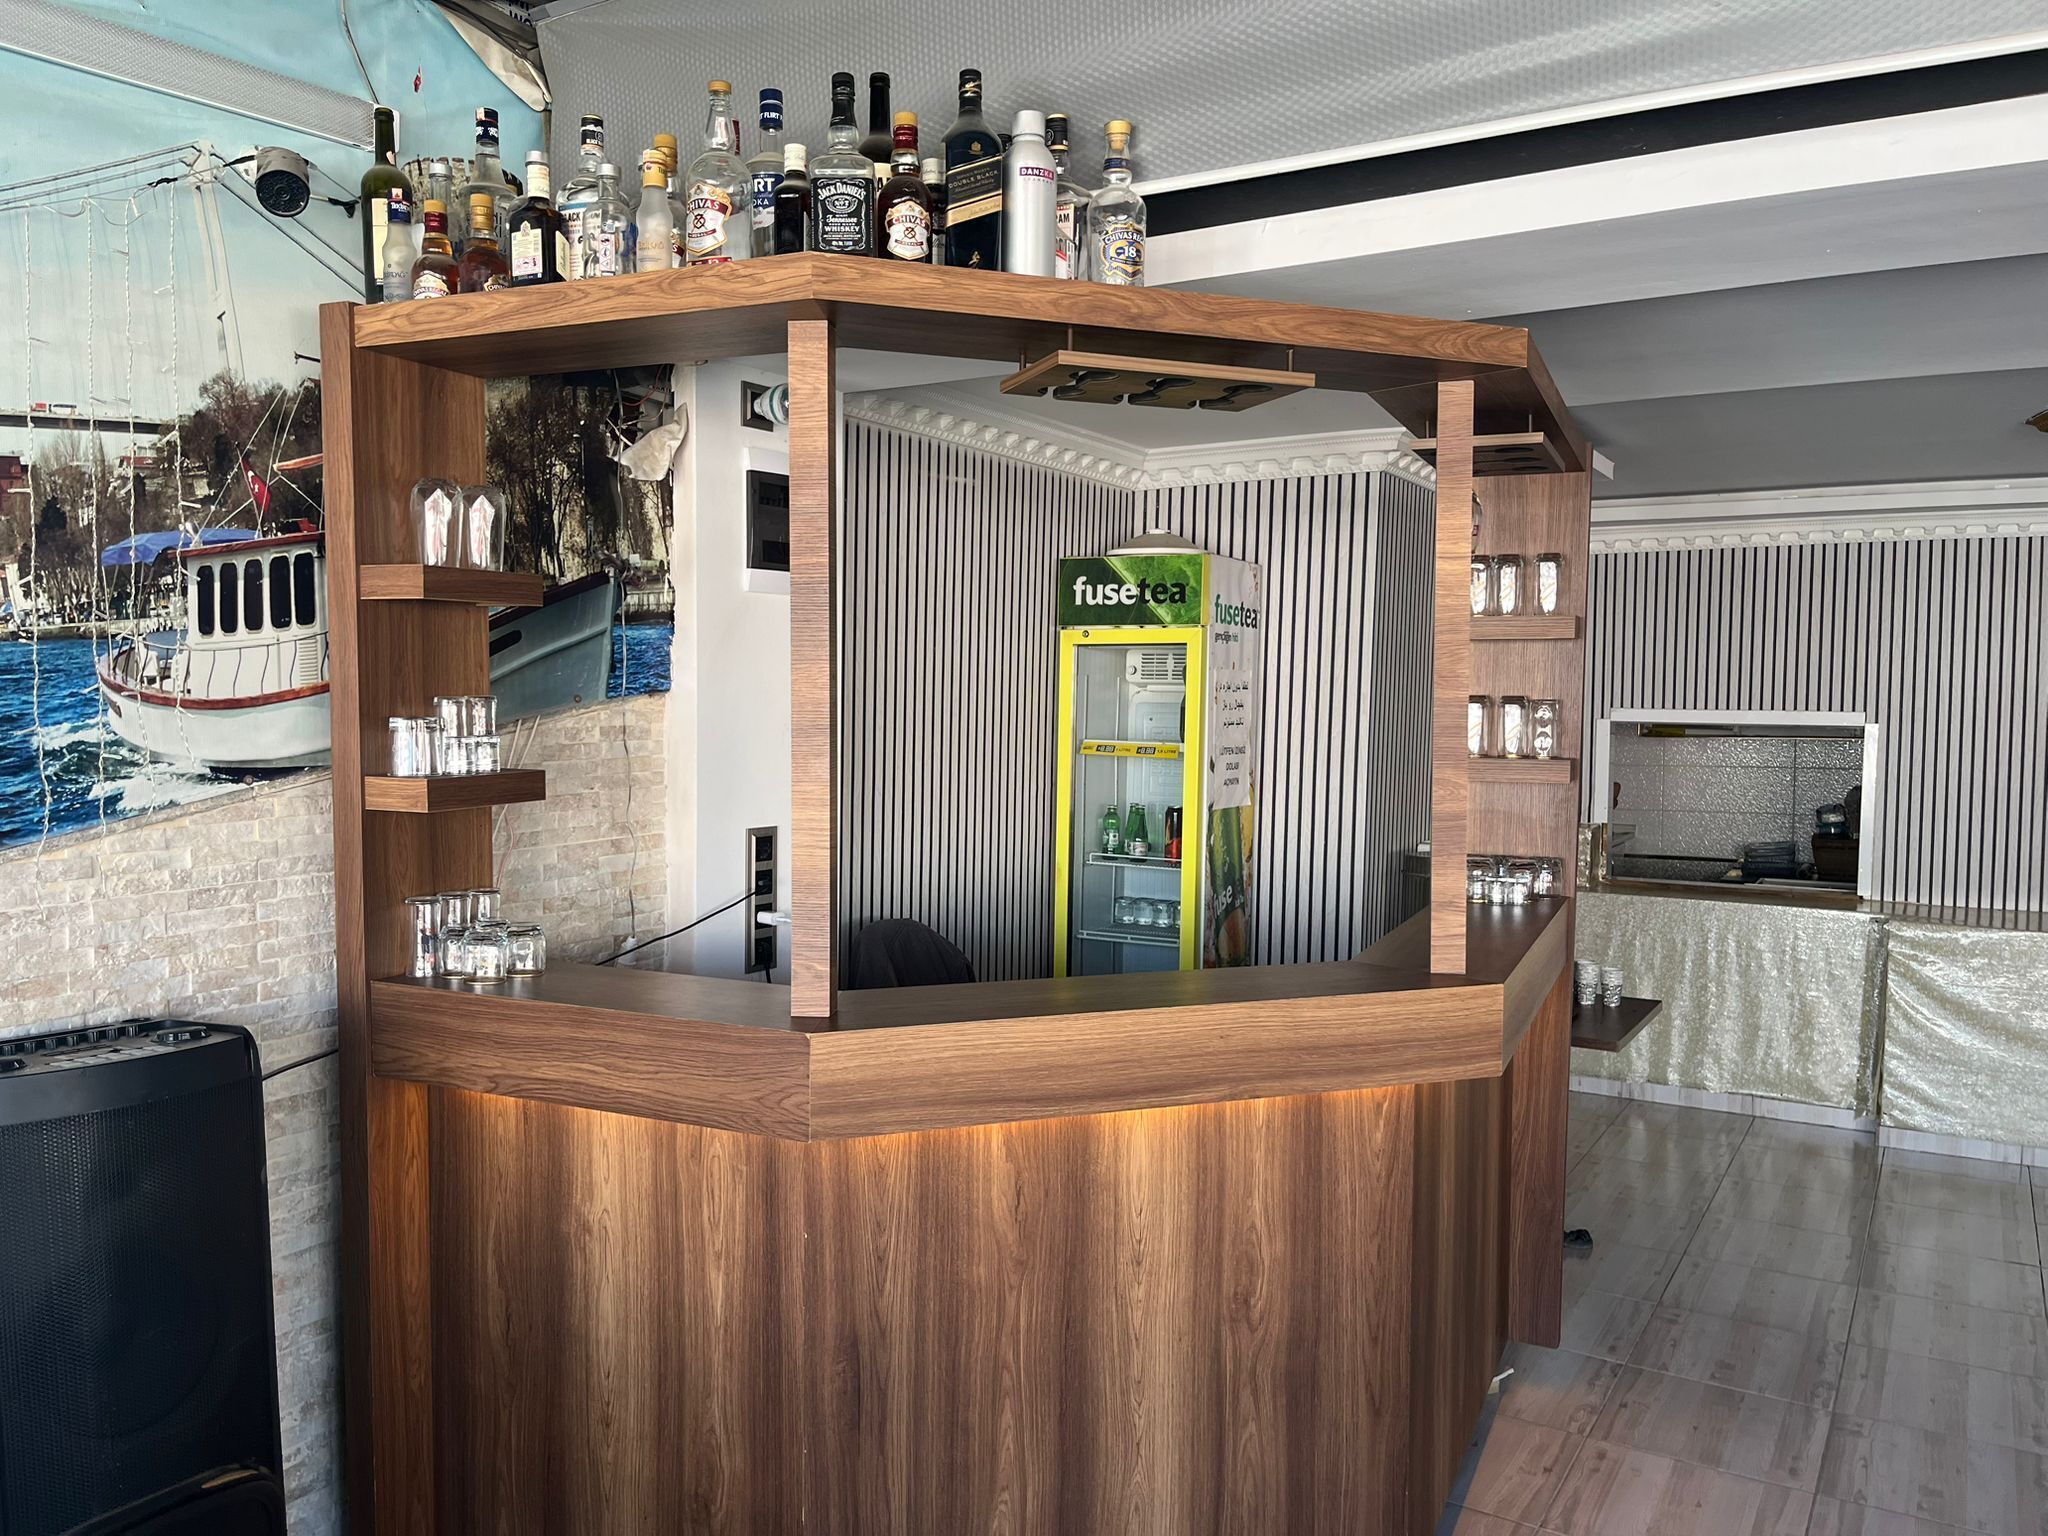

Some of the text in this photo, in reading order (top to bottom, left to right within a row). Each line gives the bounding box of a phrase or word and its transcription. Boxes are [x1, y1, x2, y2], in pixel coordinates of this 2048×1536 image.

[976, 169, 999, 181] BLACK
[1020, 168, 1053, 179] DANZKA
[817, 184, 838, 200] JACK
[892, 214, 926, 227] CHIVAS
[1104, 231, 1133, 245] CHIVAS
[1124, 246, 1137, 258] 18
